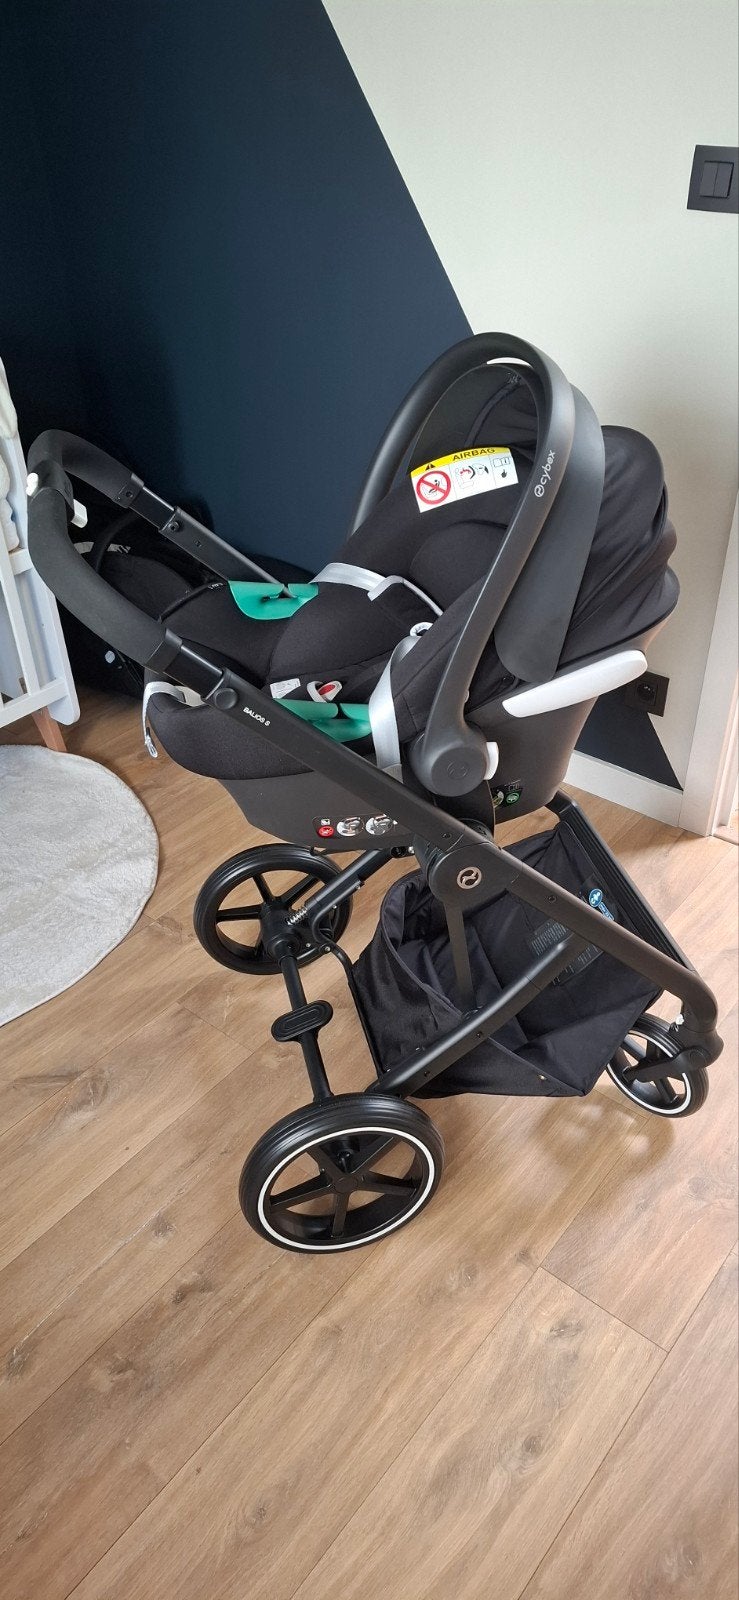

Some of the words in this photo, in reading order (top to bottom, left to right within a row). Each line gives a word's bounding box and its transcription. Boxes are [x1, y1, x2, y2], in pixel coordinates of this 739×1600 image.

[452, 447, 496, 461] AIRBAG
[540, 449, 556, 486] cybex
[243, 706, 266, 723] BALIOS
